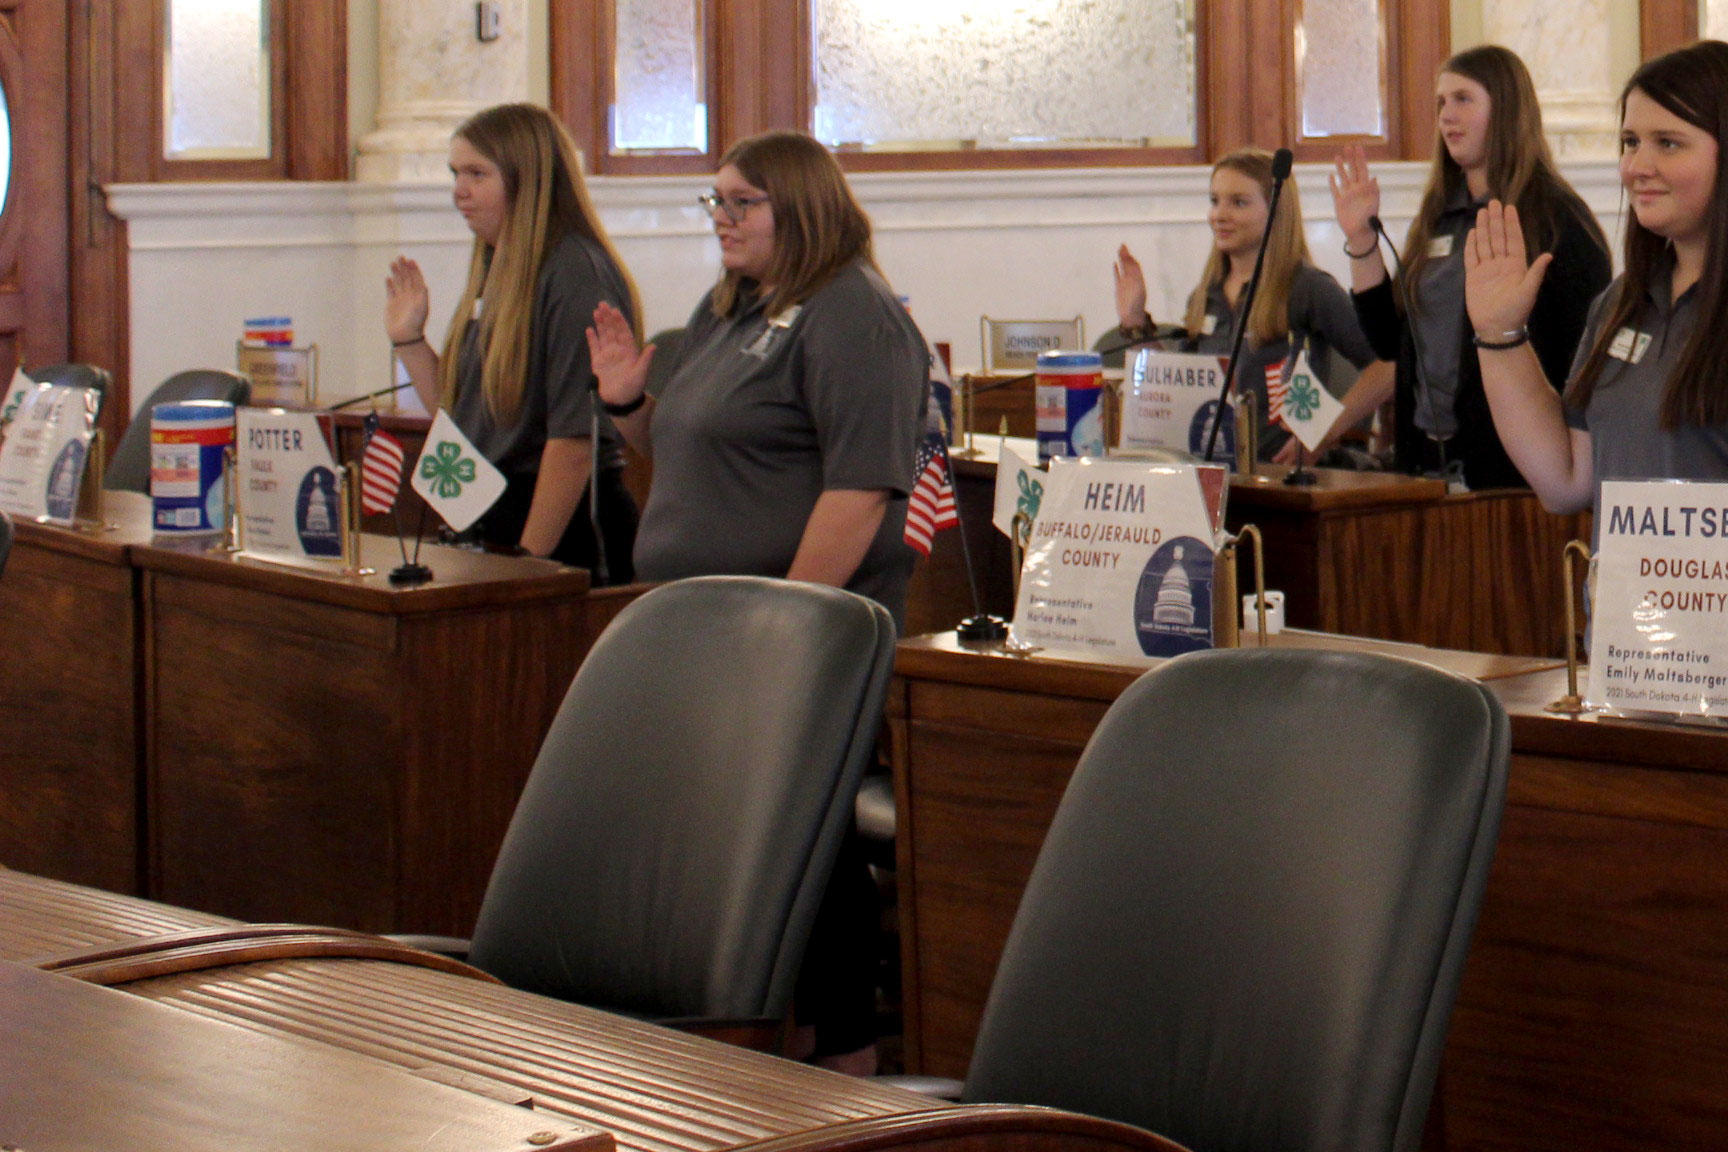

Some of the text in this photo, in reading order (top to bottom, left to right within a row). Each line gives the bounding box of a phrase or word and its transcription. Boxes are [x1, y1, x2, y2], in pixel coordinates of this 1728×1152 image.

[248, 427, 304, 452] POTTER
[1083, 482, 1147, 514] HEIM
[1036, 520, 1162, 546] BUFFALO/JERAULD
[1061, 549, 1121, 569] COUNTY
[1643, 589, 1728, 613] COUNTY
[1607, 645, 1710, 664] Representative
[1606, 665, 1728, 689] Emily Maltsberger
[1625, 687, 1647, 700] South
[1649, 689, 1680, 703] Dakota
